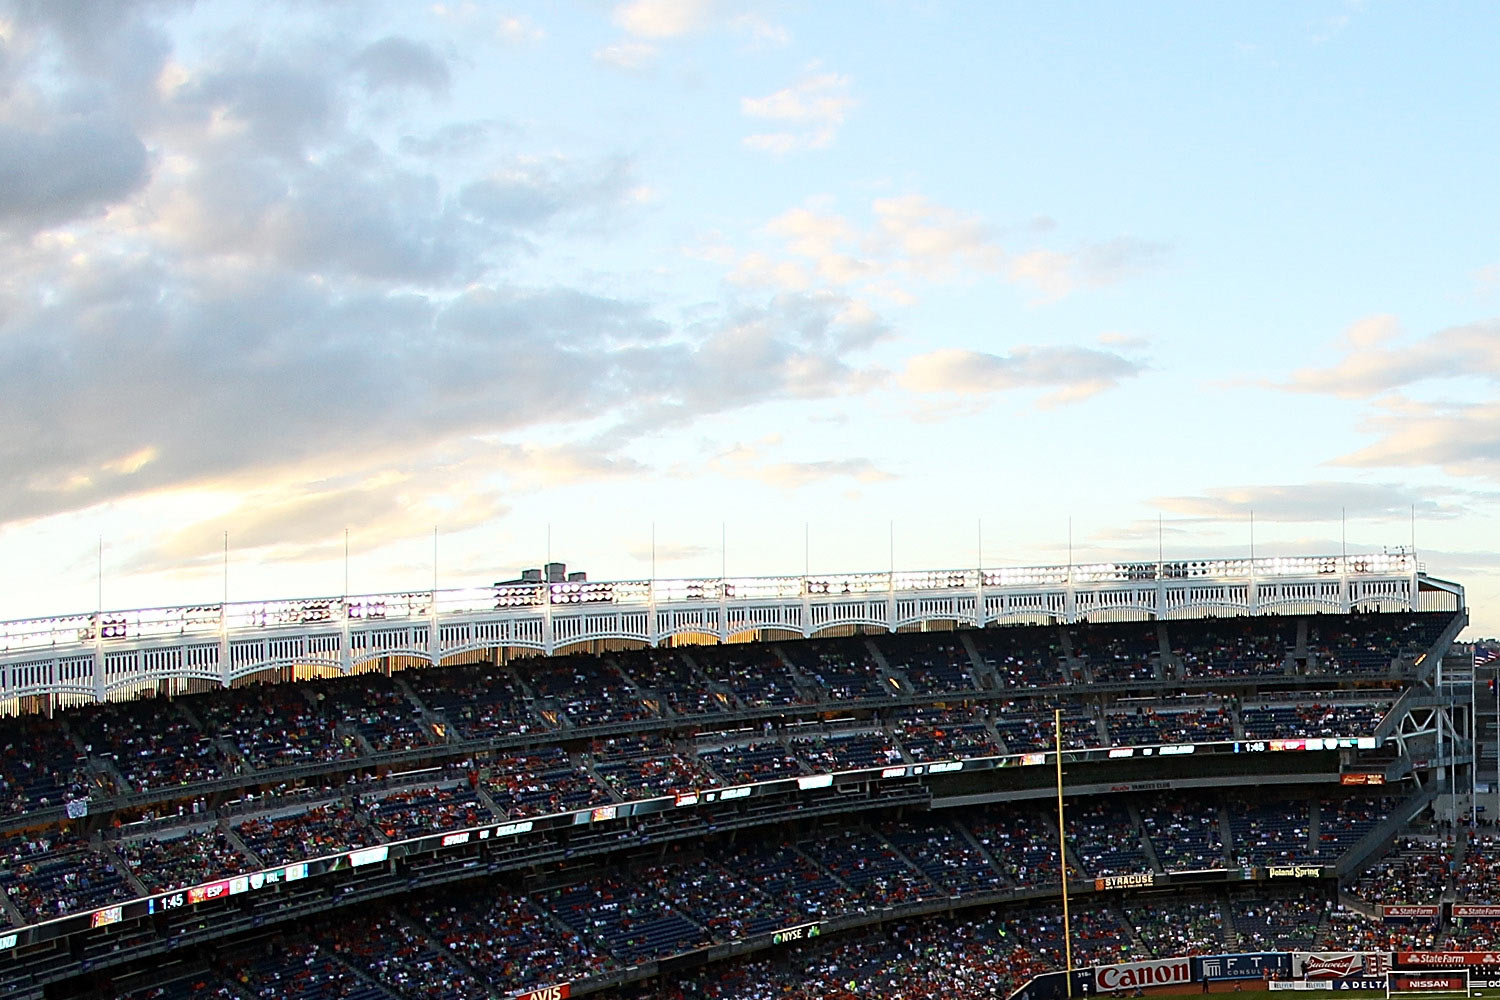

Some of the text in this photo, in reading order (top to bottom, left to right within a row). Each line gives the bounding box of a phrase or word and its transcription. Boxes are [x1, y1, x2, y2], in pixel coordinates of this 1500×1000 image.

[1269, 867, 1321, 880] Poland Spring
[1105, 875, 1154, 886] SYRACUSE
[161, 893, 184, 911] 1:45
[207, 884, 224, 898] ESP
[266, 872, 281, 885] IRL
[782, 929, 802, 943] NYSE
[1097, 962, 1190, 989] Canon
[1409, 980, 1449, 988] NISSAN
